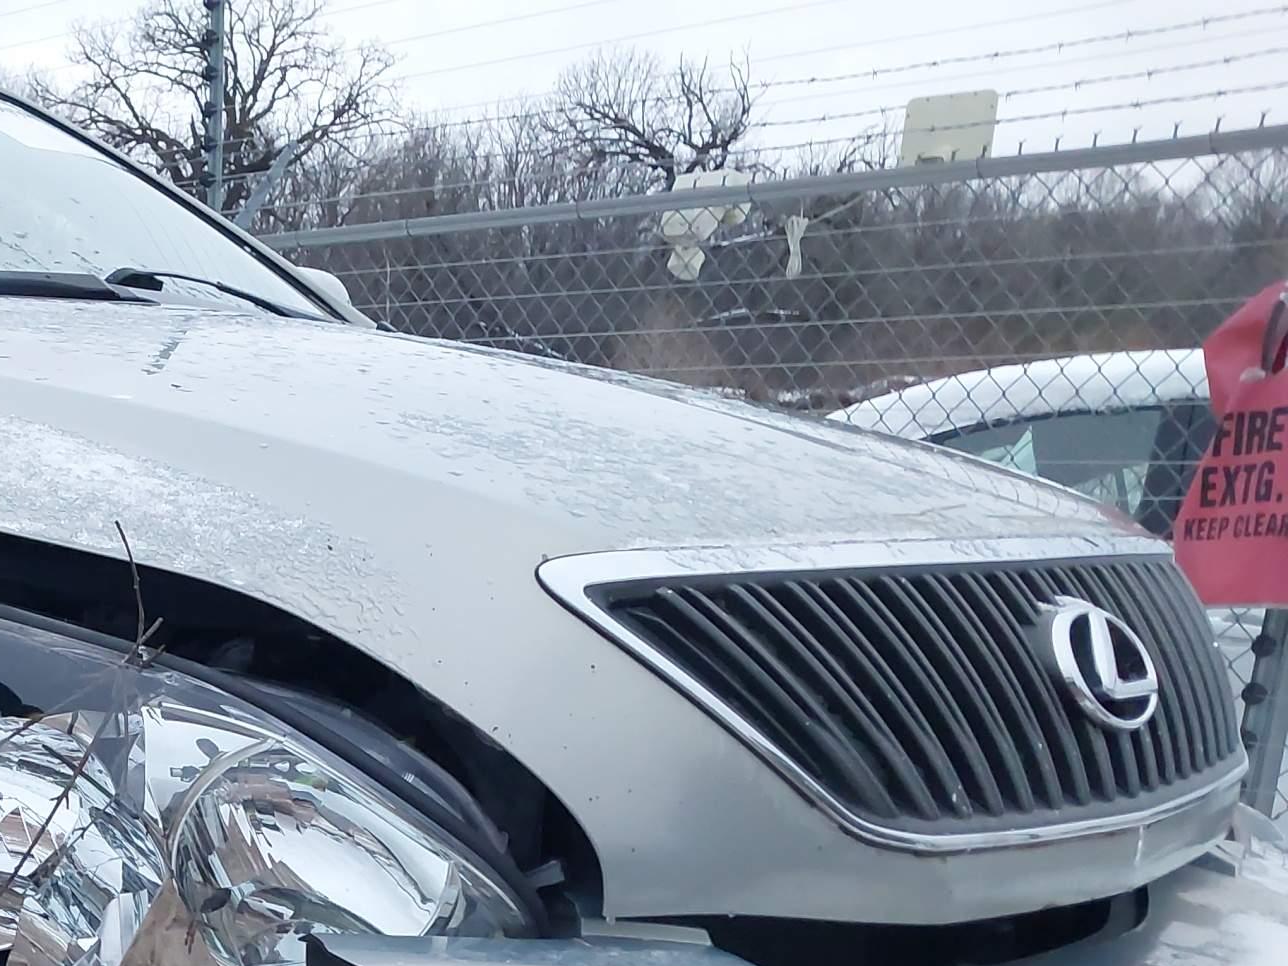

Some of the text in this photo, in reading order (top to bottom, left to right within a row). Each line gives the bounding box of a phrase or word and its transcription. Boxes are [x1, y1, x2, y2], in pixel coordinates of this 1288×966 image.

[1212, 406, 1288, 457] FIRE
[1200, 460, 1283, 508] EXTG.
[1183, 512, 1288, 541] KEEP CLEAR
